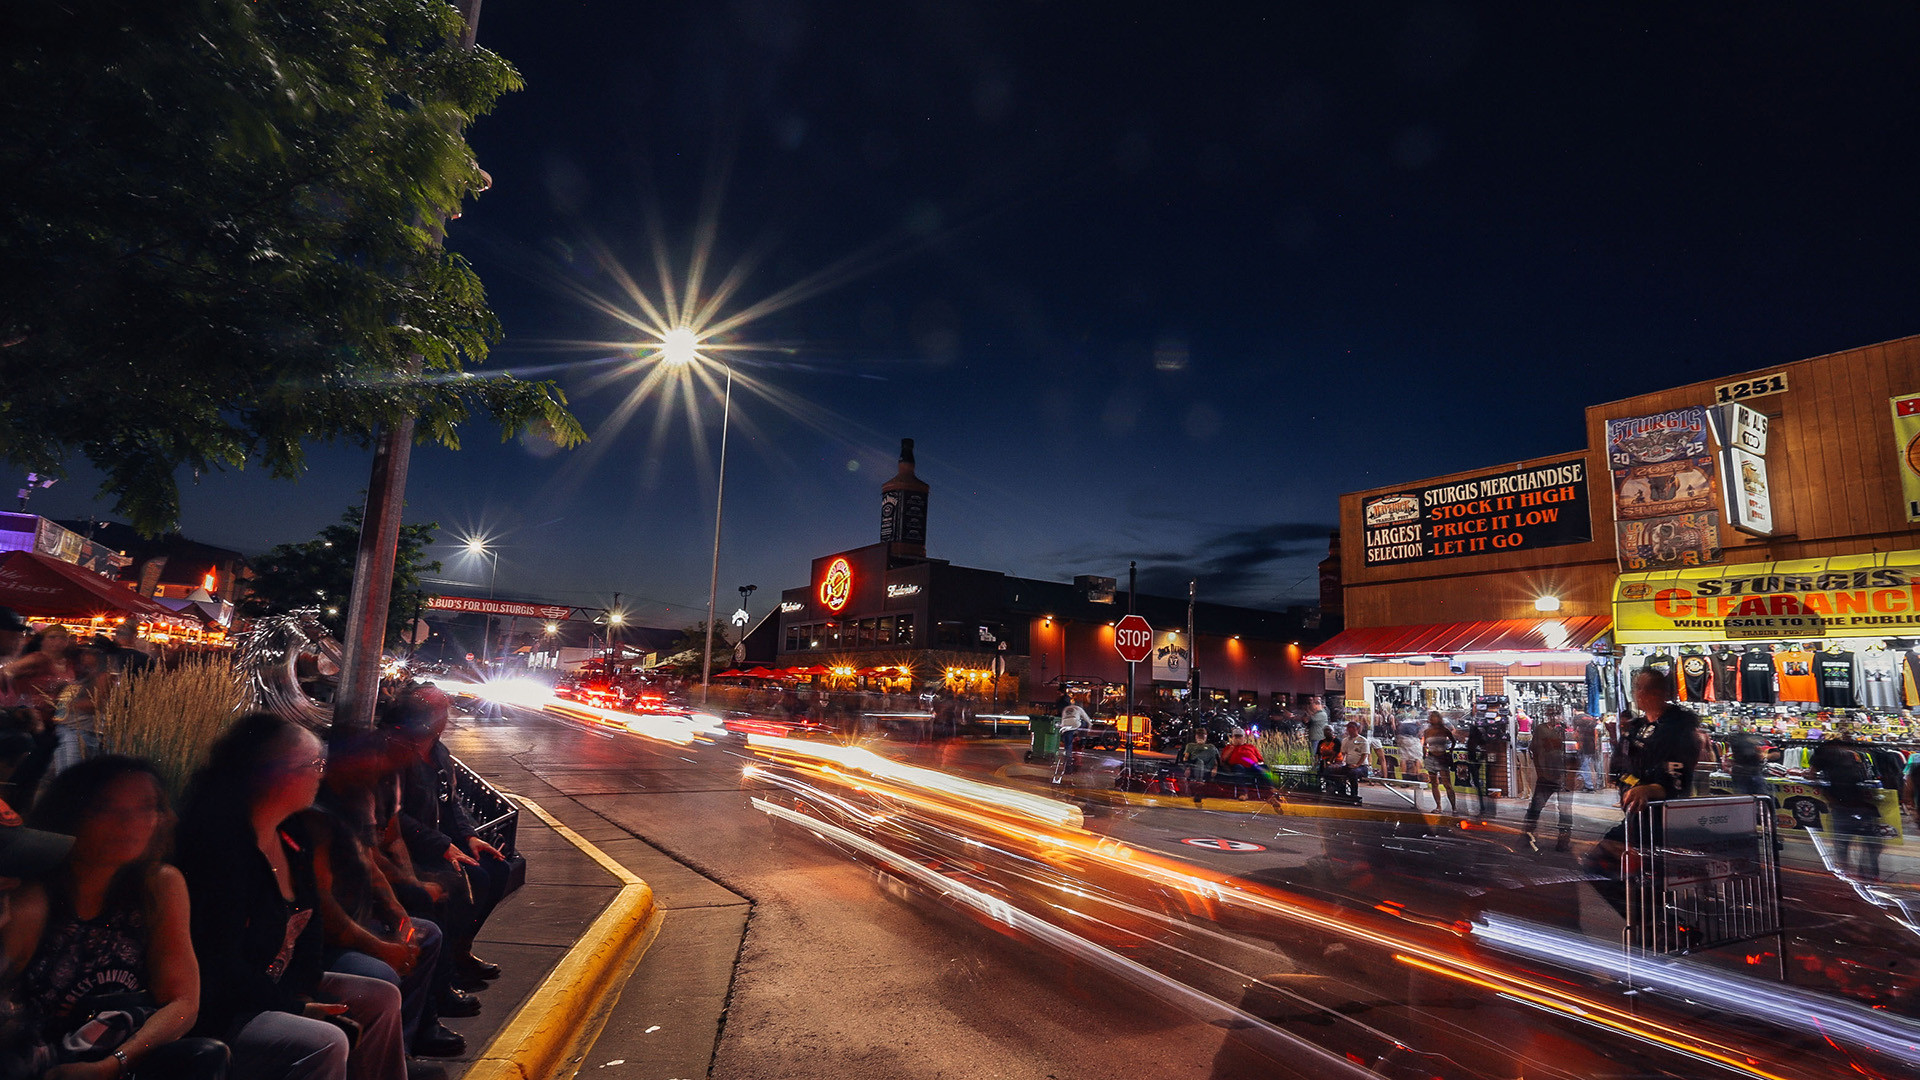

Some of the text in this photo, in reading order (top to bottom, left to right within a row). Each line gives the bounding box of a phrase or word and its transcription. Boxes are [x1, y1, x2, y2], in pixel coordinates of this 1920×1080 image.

[1717, 375, 1785, 402] 1251
[1611, 409, 1702, 444] STURGIS
[1686, 441, 1704, 456] 25
[1612, 453, 1630, 465] 20
[1636, 461, 1687, 476] 2025
[1424, 464, 1583, 507] STURGIS MERCHANDISE
[1497, 495, 1514, 511] IT
[1520, 485, 1576, 507] HIGH
[1623, 497, 1708, 516] STURGIS
[1491, 516, 1509, 531] IT
[1515, 508, 1559, 528] LOW
[1366, 524, 1422, 547] LARGEST
[1469, 537, 1487, 551] IT
[1492, 533, 1523, 549] GO
[1625, 521, 1647, 569] STURGIS
[1368, 543, 1423, 562] SELECTION
[1697, 569, 1904, 596] STURGIS
[435, 599, 462, 610] BUD'S
[463, 600, 480, 610] FOR
[481, 602, 499, 612] YOU
[500, 603, 535, 615] STURGIS
[1674, 616, 1775, 628] WHOLESALE
[1779, 617, 1803, 626] TO
[1807, 616, 1847, 627] THE
[1117, 629, 1151, 647] STOP
[1783, 784, 1804, 794] $15
